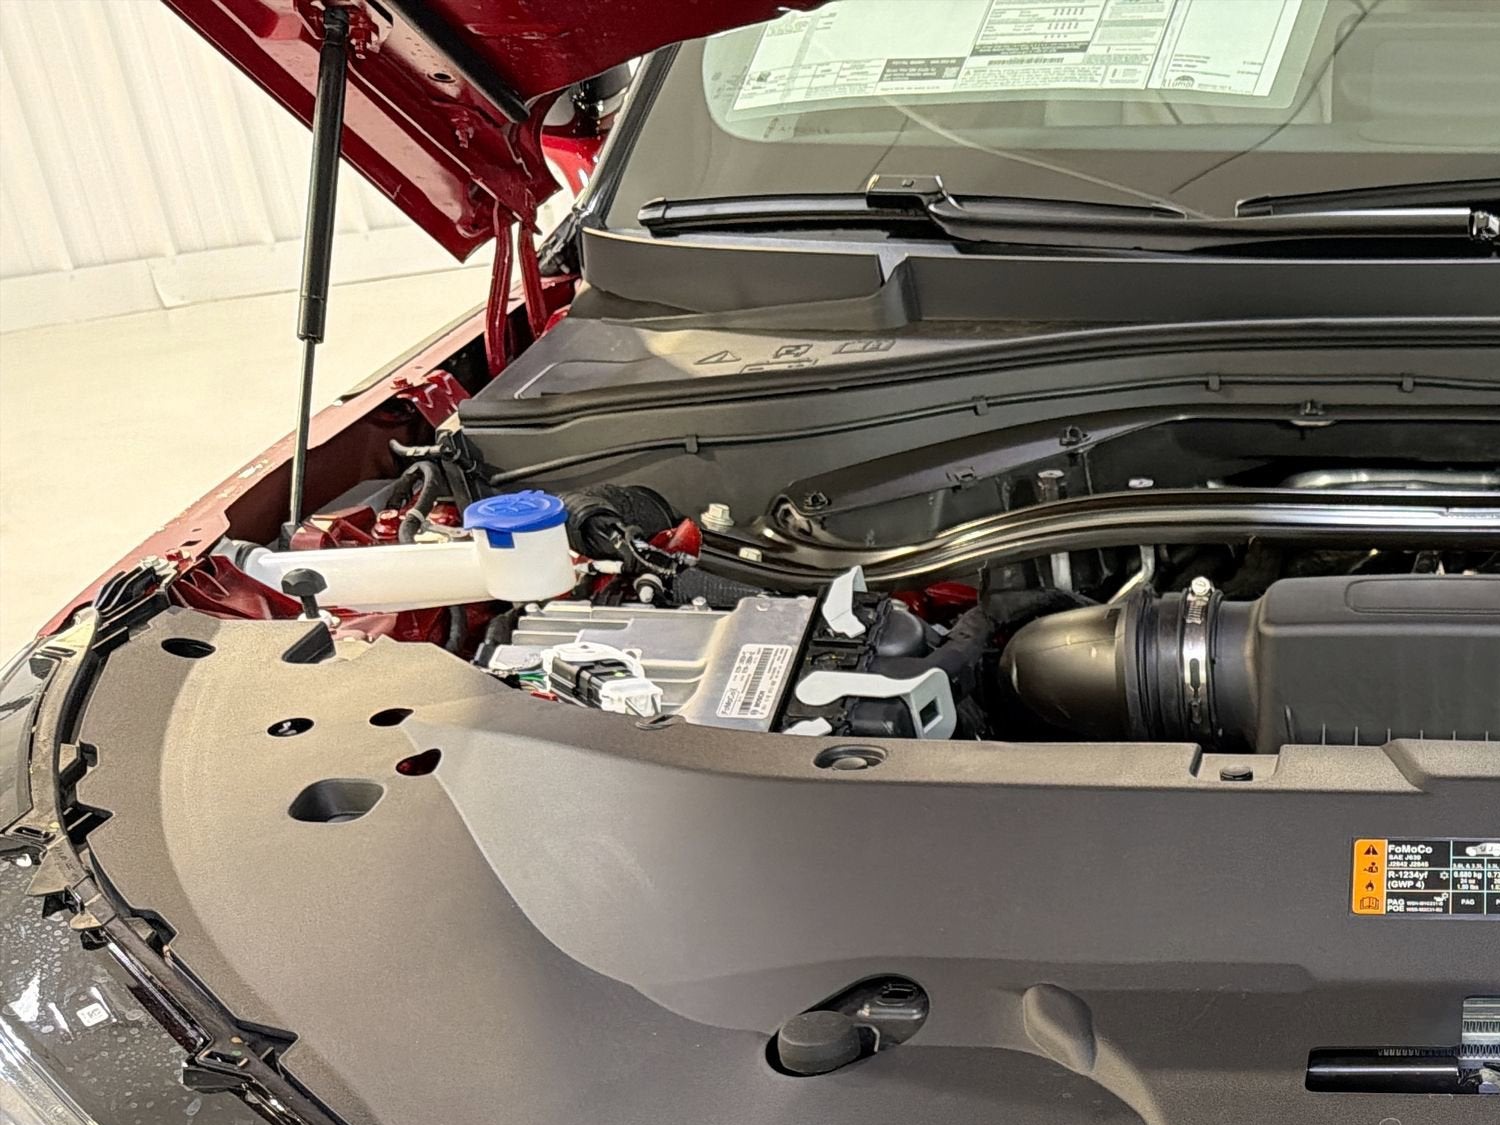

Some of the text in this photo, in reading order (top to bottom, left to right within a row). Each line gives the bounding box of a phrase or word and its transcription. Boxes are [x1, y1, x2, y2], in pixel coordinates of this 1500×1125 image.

[1388, 844, 1433, 854] FoMoCo
[1388, 871, 1429, 880] R-1234yf
[1473, 871, 1482, 880] kg
[1387, 881, 1425, 889] (GWP 4)
[1461, 898, 1475, 906] PAG
